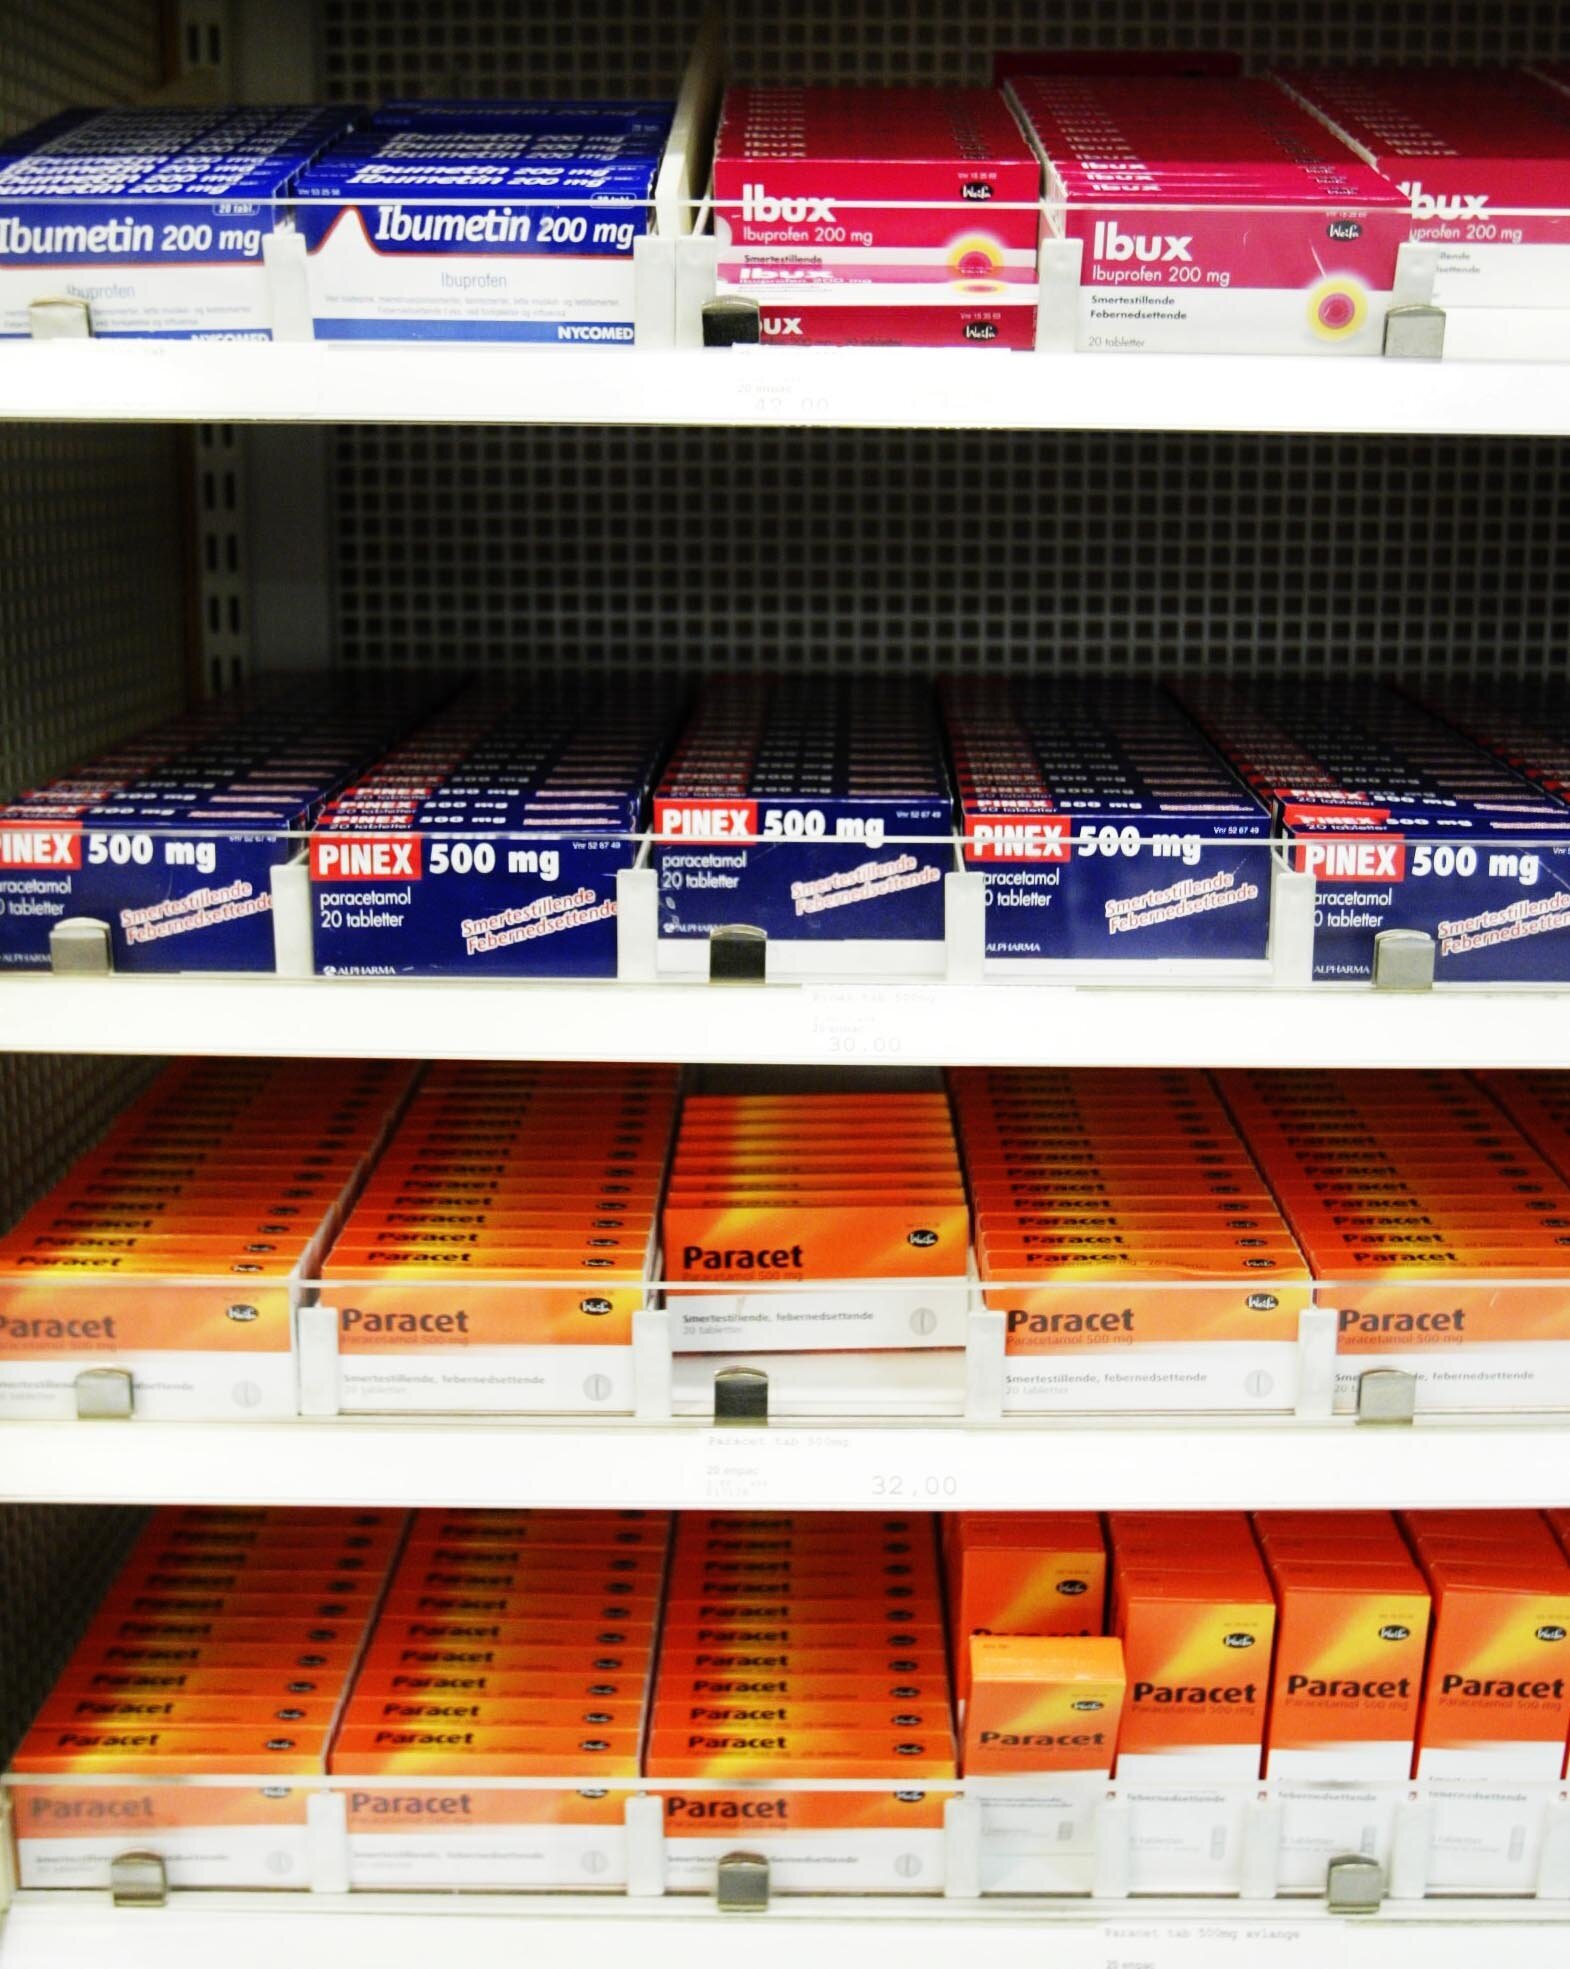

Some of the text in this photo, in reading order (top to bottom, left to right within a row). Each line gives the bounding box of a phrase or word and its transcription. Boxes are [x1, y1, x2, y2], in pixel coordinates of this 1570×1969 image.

[346, 172, 606, 189] Ibumetin 200 mg
[742, 183, 837, 223] Ibux
[0, 217, 261, 257] Ibumetin 200 mg
[375, 205, 635, 250] Ibumetin 200 mg
[743, 226, 873, 248] Ibuprofen 200 mg
[1409, 223, 1523, 245] uprofen 200 mg
[1093, 220, 1193, 261] Ibux
[441, 272, 508, 291] Ibuprofen
[1092, 266, 1230, 287] Ibuprofen 200 mg
[1091, 295, 1176, 305] Smertestillende
[1090, 310, 1188, 320] Febernedsettende
[558, 326, 635, 342] NYCOMED
[1088, 337, 1103, 348] 20
[662, 808, 885, 849] PINEX 500 mg
[0, 833, 216, 873] INEX 500 mg
[972, 825, 1202, 866] PINEX 500 mg
[317, 842, 560, 881] PINEX 500 mg
[661, 850, 747, 870] paracetamol
[1303, 845, 1540, 885] PINEX 500 mg
[662, 871, 741, 889] 20 tabletter
[790, 853, 918, 901] Smertestillende
[983, 867, 1060, 886] aracetamol
[319, 886, 412, 908] paracetamol
[794, 866, 941, 917] Febernedsettende
[997, 890, 1053, 907] tabletter
[1104, 870, 1235, 919] Smertestillende
[1314, 887, 1393, 906] aracetamol
[9, 897, 65, 916] tabletter
[119, 879, 253, 929] Smertestillende
[461, 886, 597, 938] Smertestillende
[1108, 883, 1259, 936] Febernedsettende
[320, 909, 405, 928] 20 tabletter
[1326, 908, 1384, 928] tabletter
[986, 942, 1041, 952] ALPHARMA
[337, 965, 396, 976] ALPHARMA
[1313, 963, 1371, 974] ALPHARMA
[367, 1251, 473, 1264] Paracet
[683, 1245, 804, 1270] Paracet
[1026, 1252, 1130, 1264] Paracet
[342, 1308, 469, 1333] Paracet
[1007, 1308, 1134, 1333] Paracet
[1338, 1308, 1465, 1333] Paracet
[1007, 1334, 1134, 1347] Paracetamol 500 mg
[1337, 1333, 1464, 1347] Paracetamol 500 mg
[1133, 1681, 1257, 1703] Paracet
[1287, 1674, 1411, 1699] Paracet
[1441, 1673, 1565, 1699] Paracet
[374, 1732, 475, 1745] Paracet
[688, 1735, 787, 1749] Paracet
[980, 1730, 1105, 1746] Paracet
[32, 1797, 154, 1818] Paracet
[352, 1794, 472, 1815] Paracet
[668, 1797, 788, 1819] Paracet
[1104, 1927, 1160, 1939] Paracet
[1167, 1927, 1191, 1938] tab
